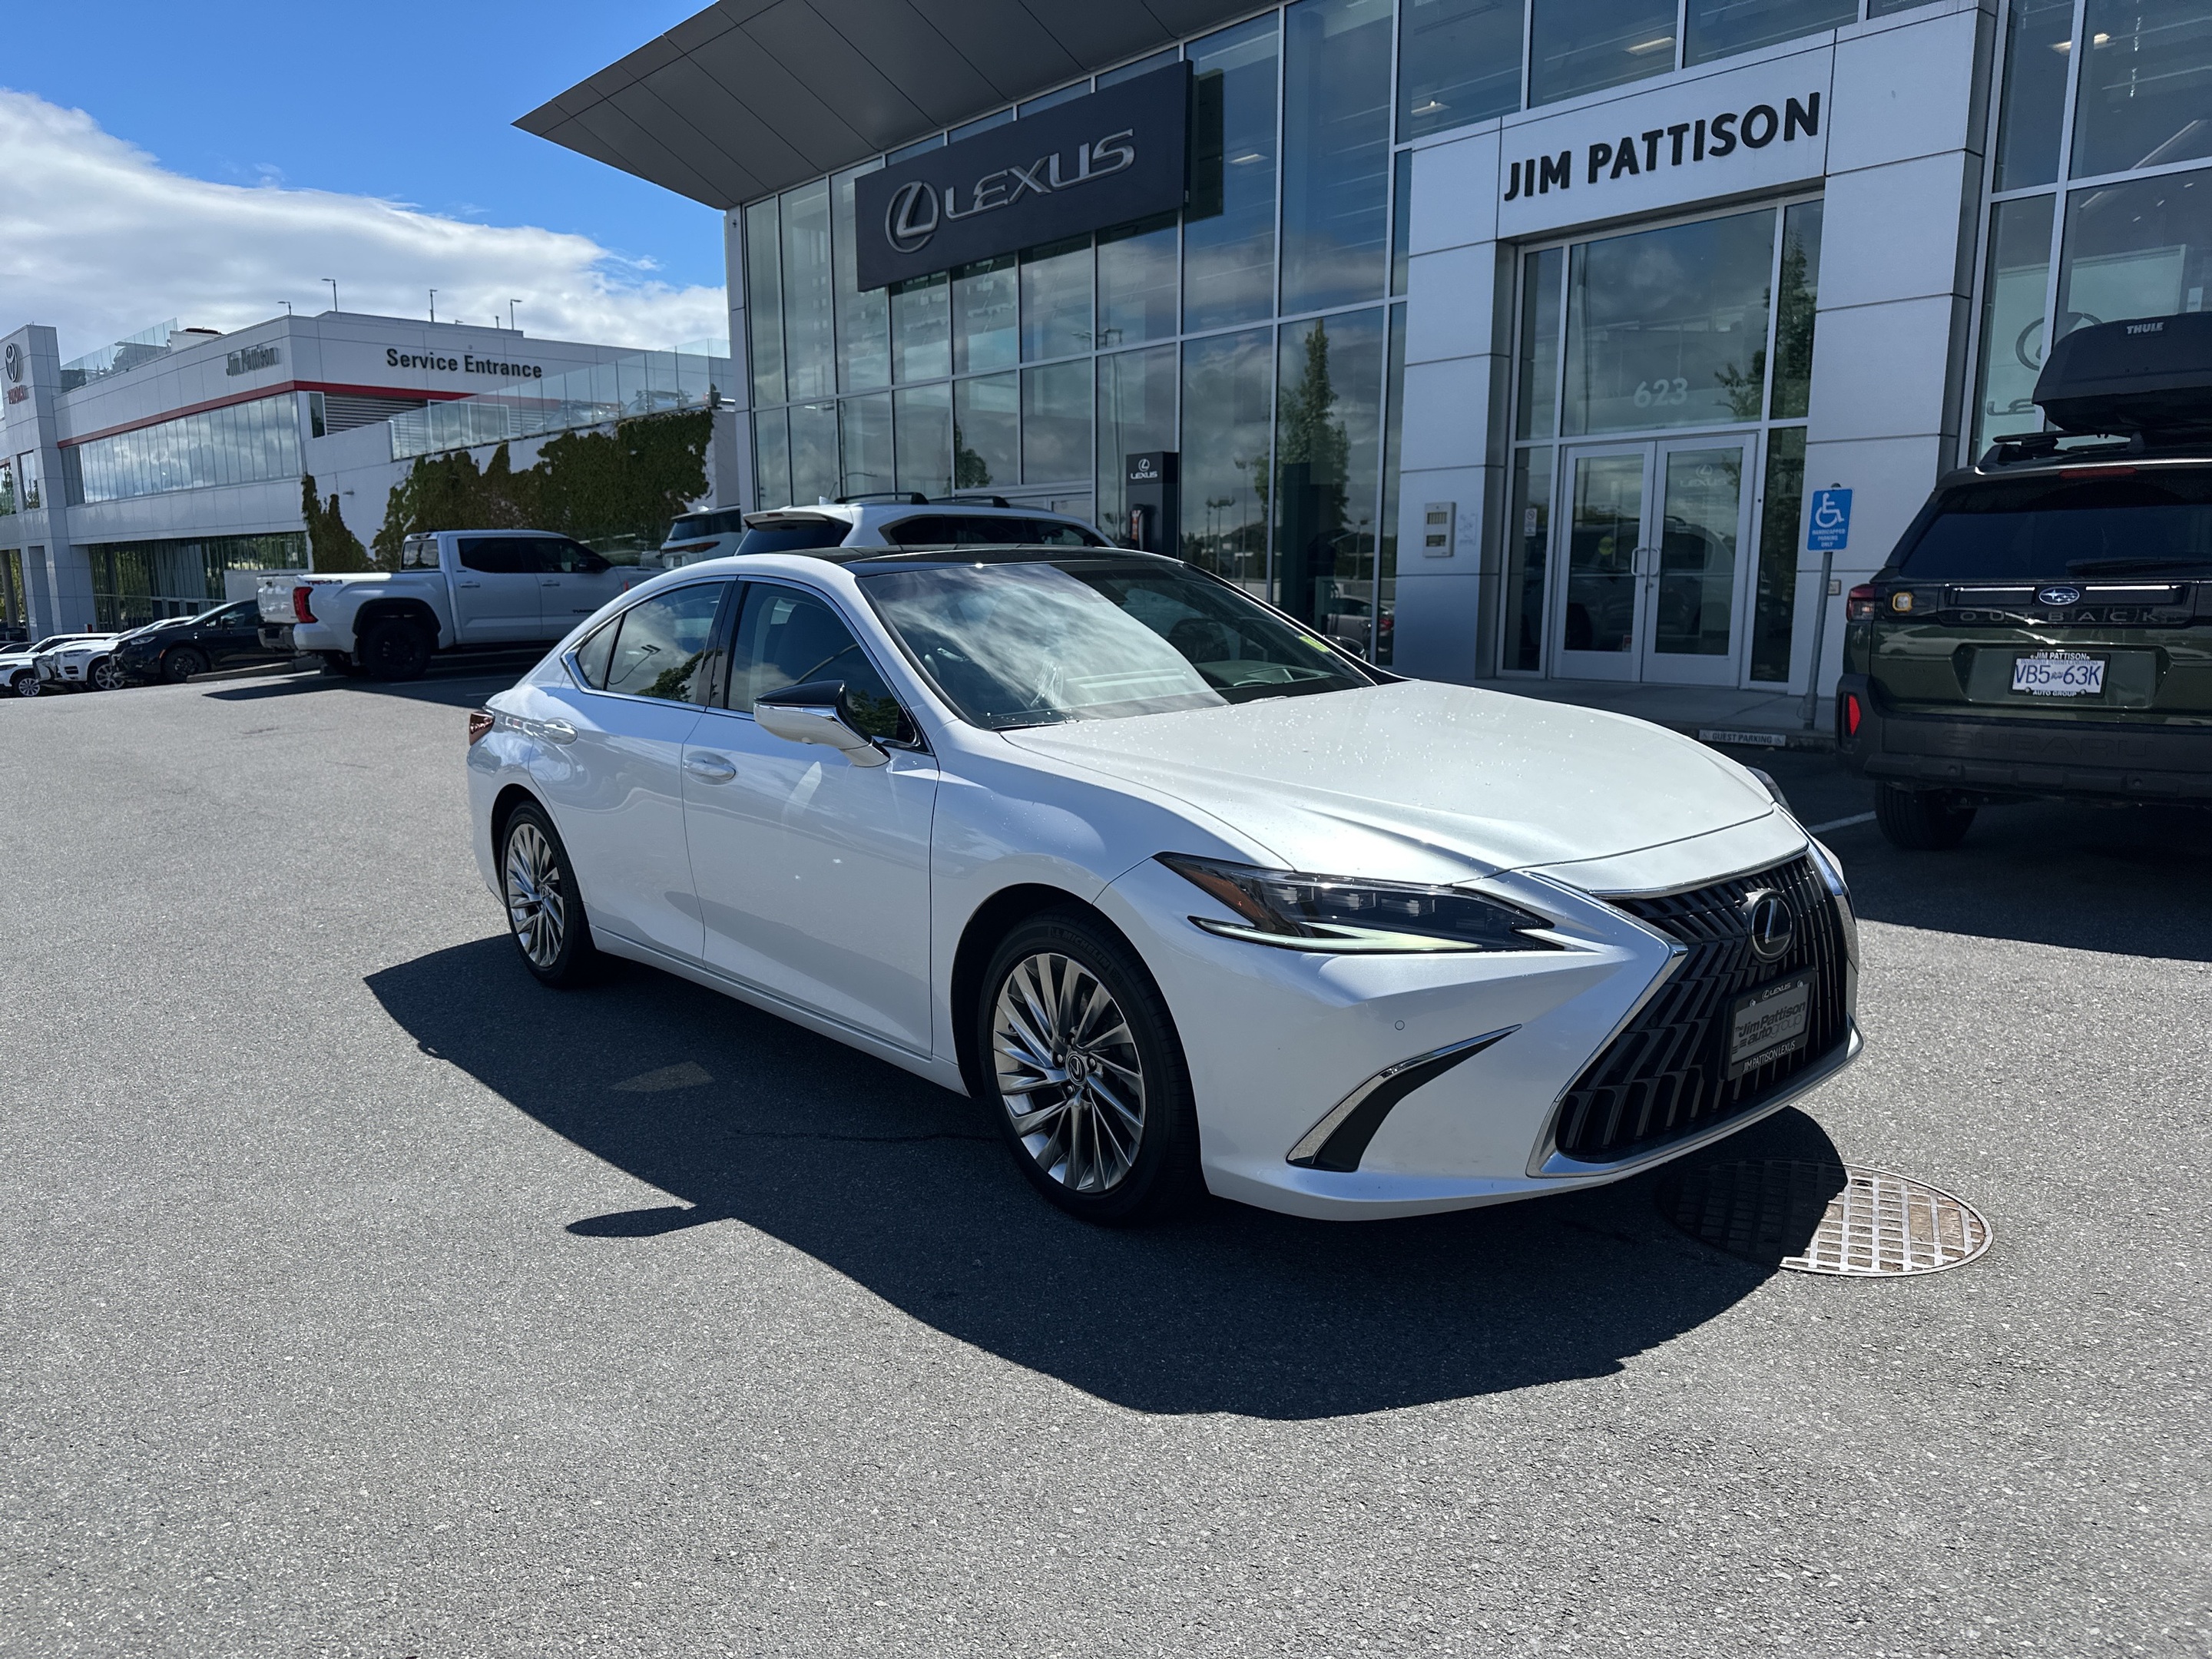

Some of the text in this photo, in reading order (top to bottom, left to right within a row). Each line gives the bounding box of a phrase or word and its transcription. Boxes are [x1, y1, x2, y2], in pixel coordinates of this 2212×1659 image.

[1504, 91, 1820, 201] JIM PATTISON
[945, 128, 1135, 220] LEXUS
[2127, 322, 2164, 335] THULE
[226, 344, 276, 376] Jim Pattison
[386, 348, 542, 379] Service Entrance
[1634, 377, 1688, 408] 623
[1130, 471, 1158, 480] LEXUS
[1959, 611, 2160, 623] OUTBACK
[2035, 651, 2087, 661] JIM PATTISON
[2015, 664, 2101, 686] VB5 63K
[1712, 732, 1773, 744] GUEST PARKING
[1770, 982, 1792, 995] LEXUS
[1761, 1002, 1806, 1027] Pattison
[1743, 1040, 1796, 1073] JIM PATTISON LEXUS
